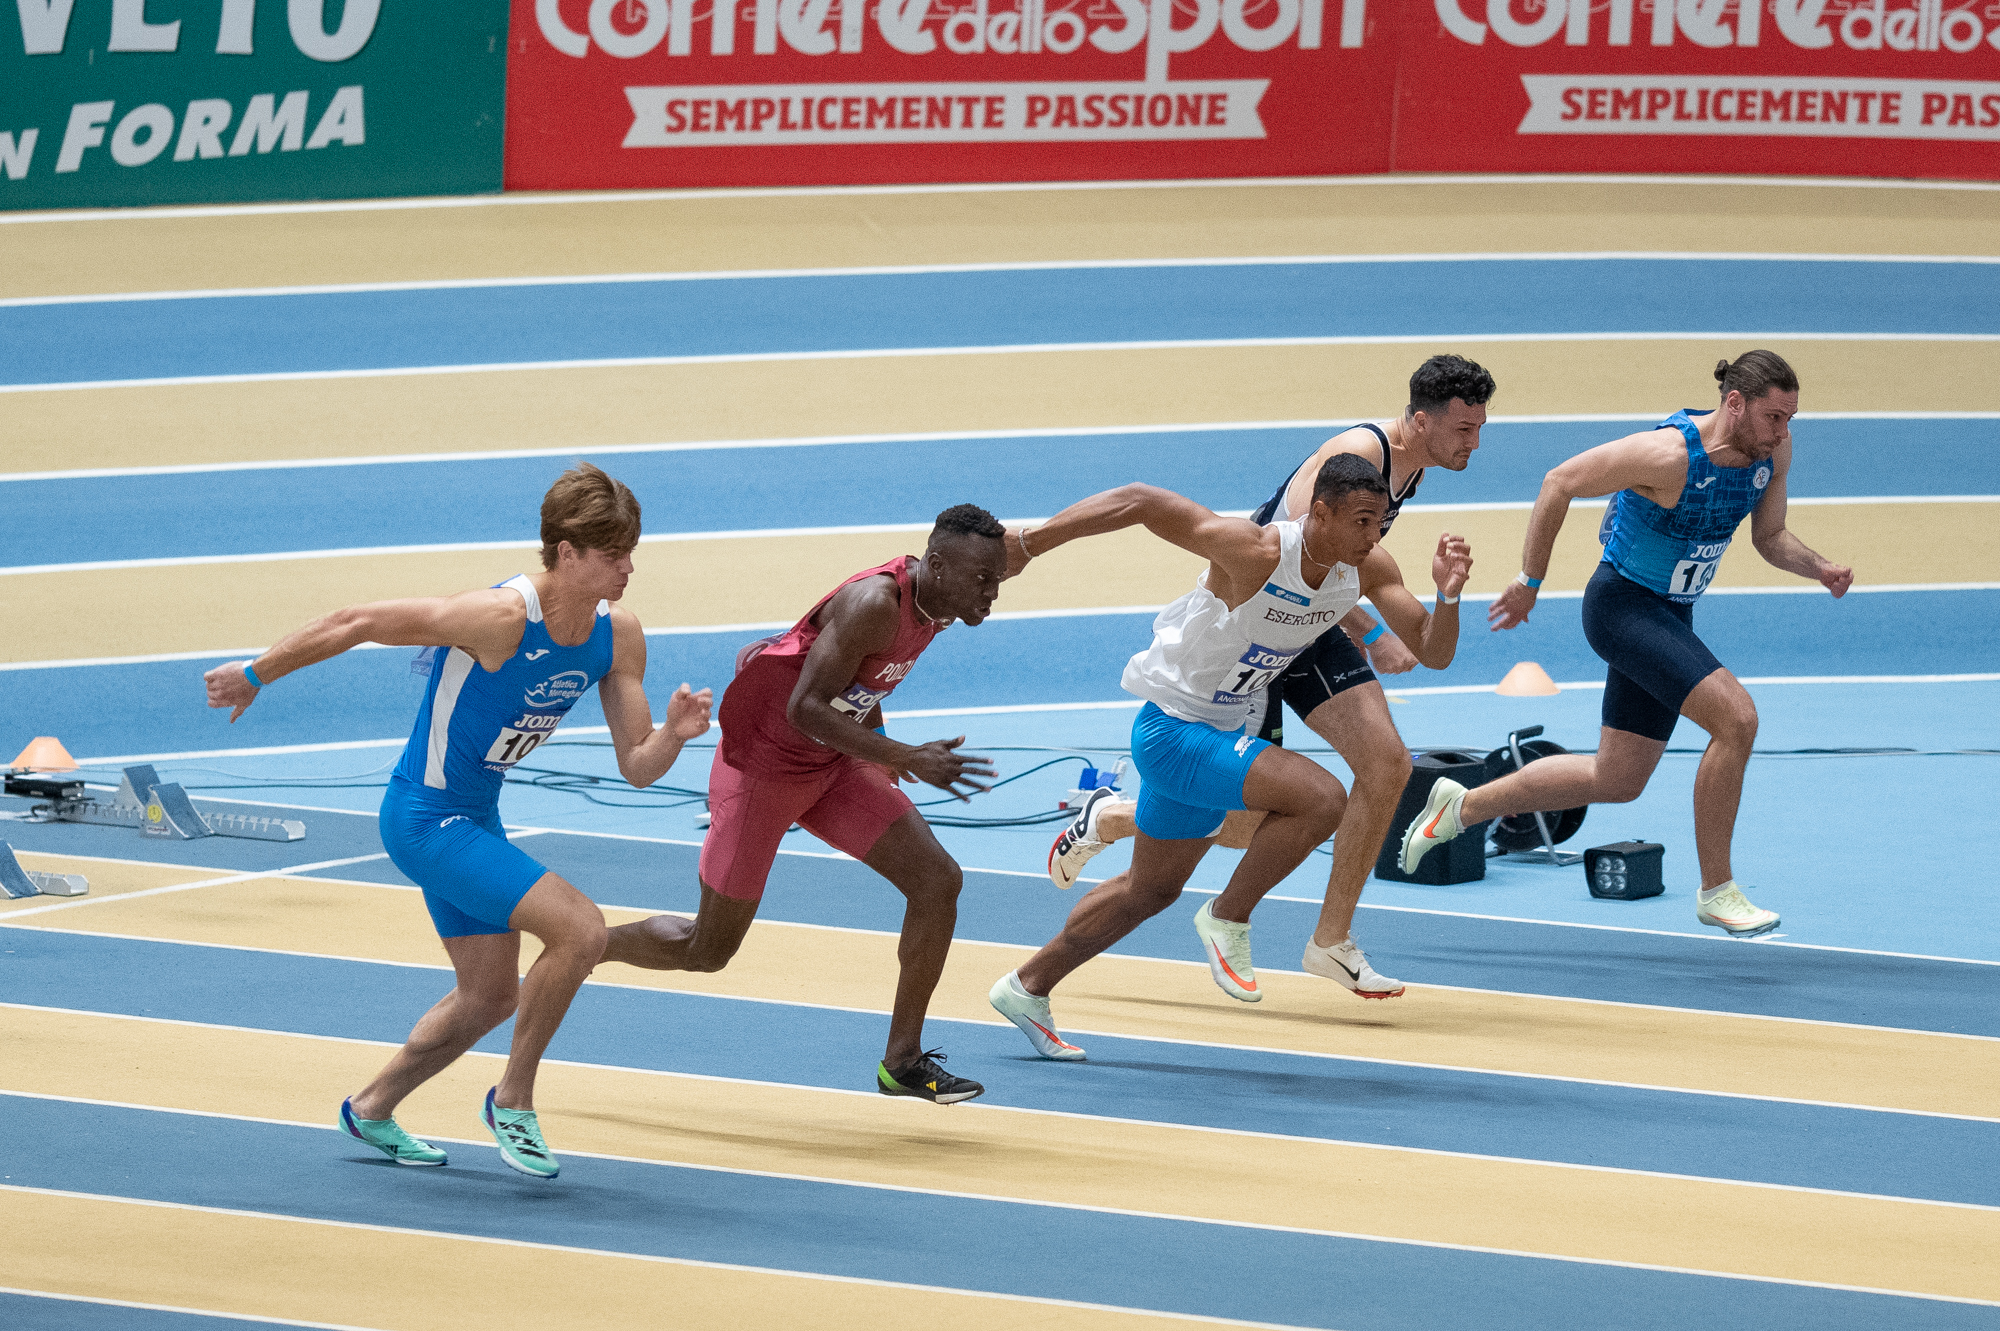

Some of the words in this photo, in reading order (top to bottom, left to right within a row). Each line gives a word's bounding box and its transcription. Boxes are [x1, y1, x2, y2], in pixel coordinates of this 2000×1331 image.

[665, 96, 1005, 133] SEMPLICEMENTE
[1024, 94, 1228, 128] PASSIONE
[1561, 87, 1901, 125] SEMPLICEMENTE
[55, 85, 365, 173] FORMA
[1263, 607, 1336, 626] ESERCITO
